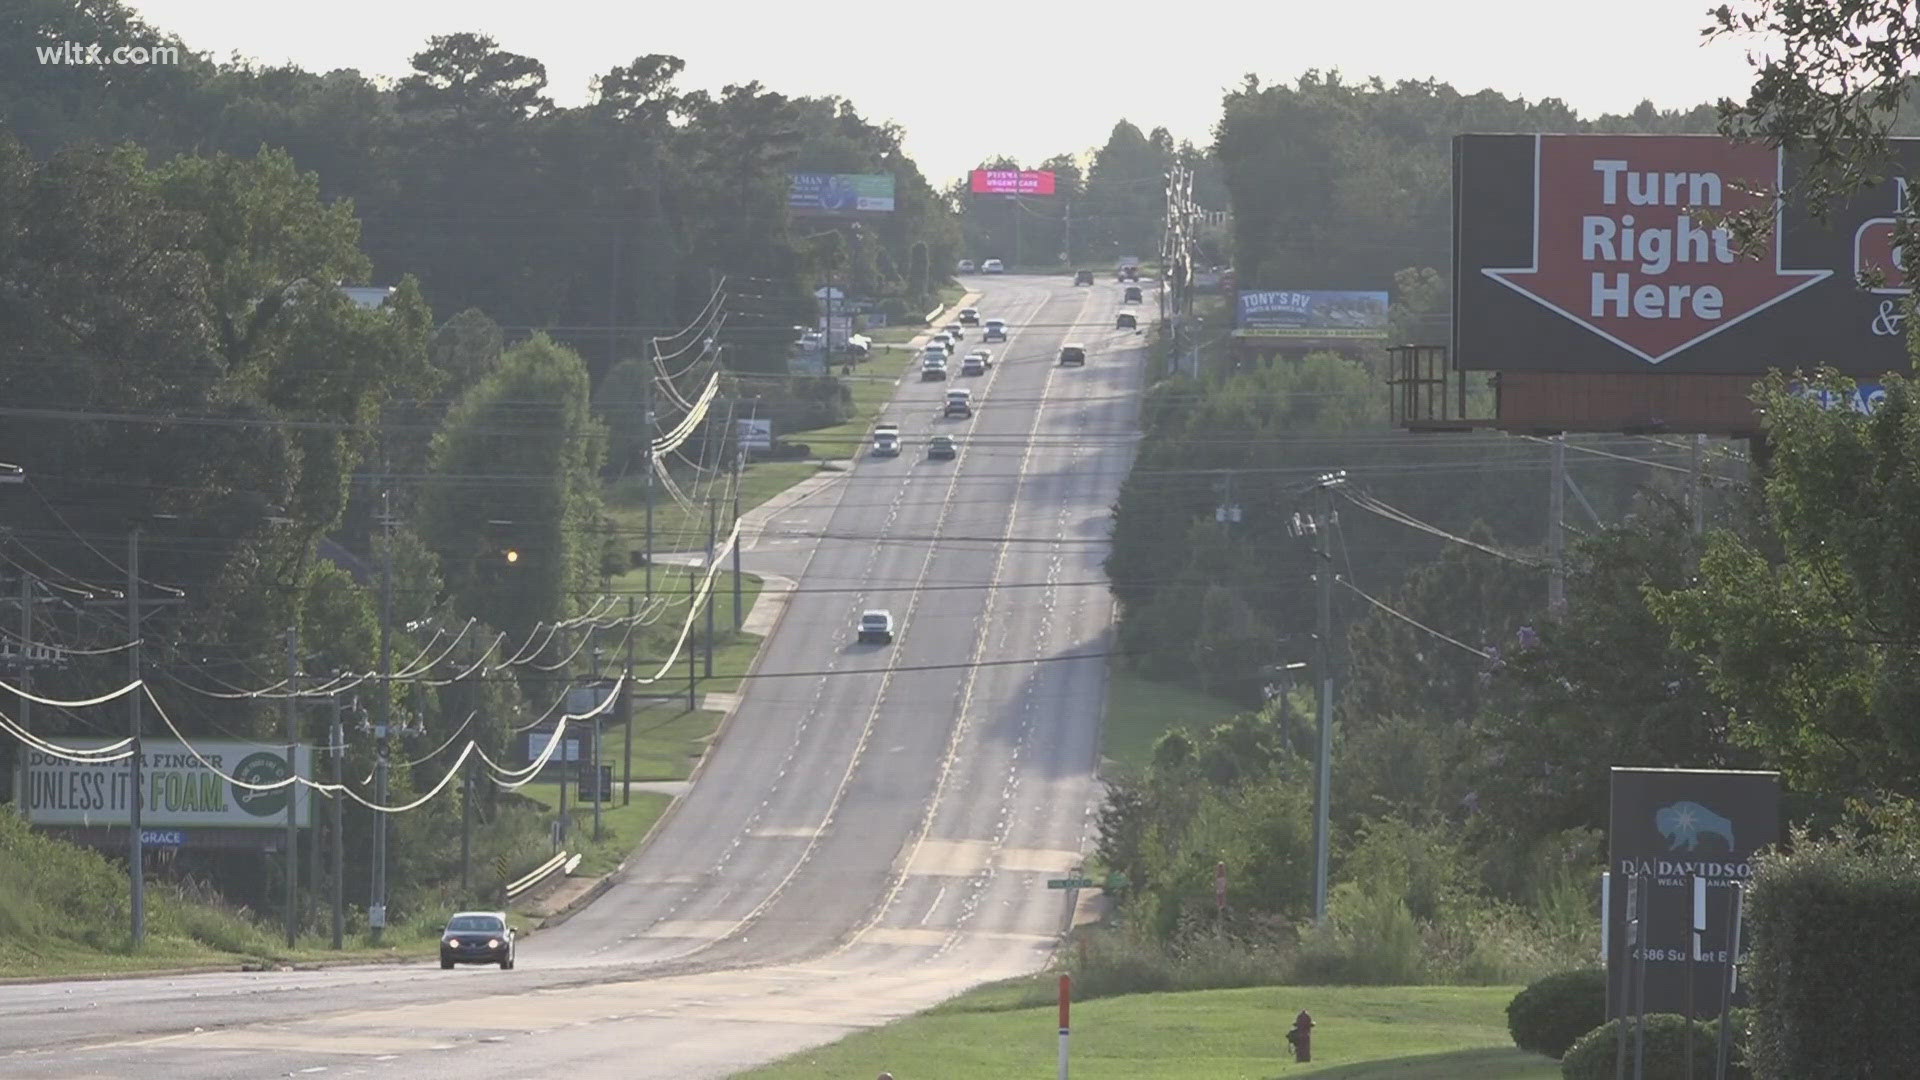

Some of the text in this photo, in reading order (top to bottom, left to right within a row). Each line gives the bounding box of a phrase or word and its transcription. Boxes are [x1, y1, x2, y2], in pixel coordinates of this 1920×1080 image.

[1593, 159, 1723, 207] Turn
[1582, 214, 1736, 276] Right
[1241, 292, 1311, 308] TONY'S RV
[1591, 271, 1724, 321] Here
[153, 754, 223, 769] FINGER
[30, 771, 104, 811] UNLESS
[140, 832, 181, 844] GRACE
[1668, 949, 1714, 963] Suet
